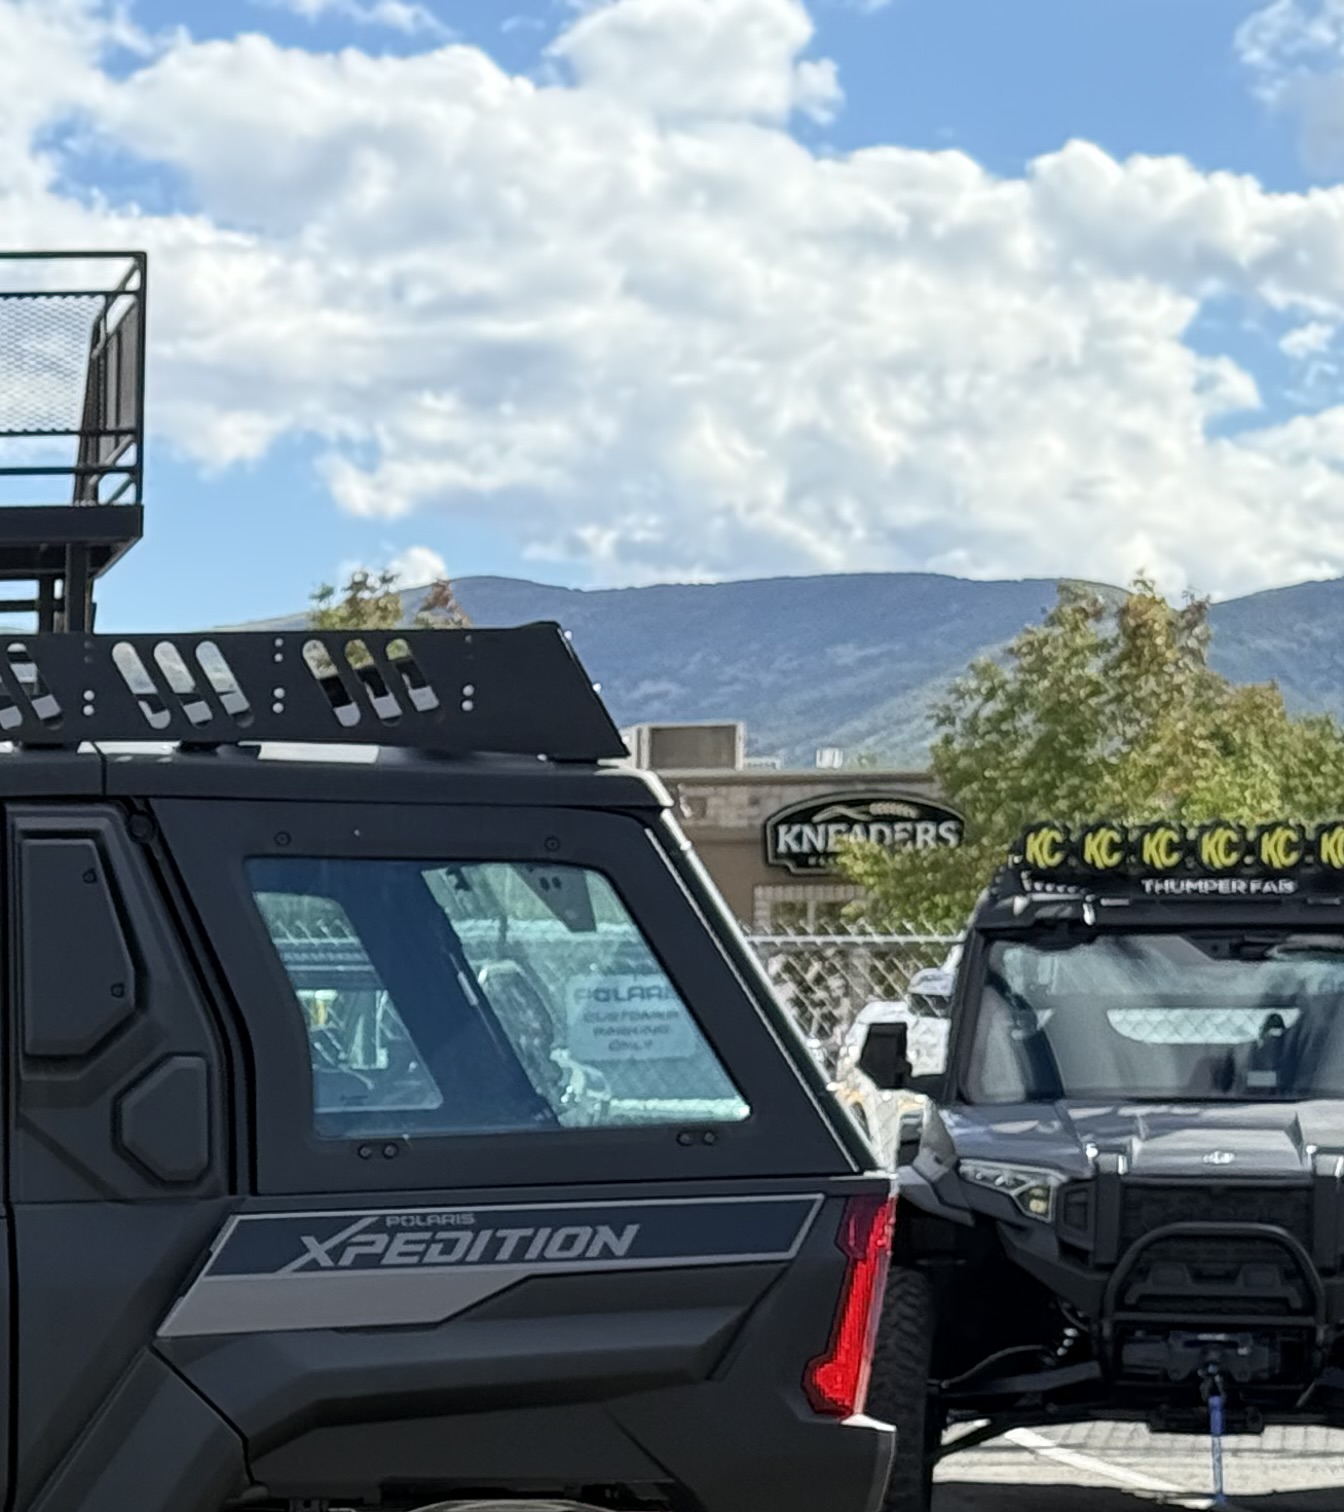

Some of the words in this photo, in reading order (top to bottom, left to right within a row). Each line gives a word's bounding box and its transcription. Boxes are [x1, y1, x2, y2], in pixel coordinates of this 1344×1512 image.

[777, 820, 960, 854] KNEADERS
[1026, 828, 1063, 869] KC
[1084, 827, 1122, 870] KC
[1143, 827, 1180, 869] KC
[1201, 827, 1240, 870] KC
[1261, 827, 1300, 869] KC
[1321, 826, 1344, 869] K
[1141, 878, 1247, 894] THUMPER
[1250, 877, 1298, 895] FAB
[385, 1212, 475, 1228] POLARIS
[274, 1215, 641, 1276] XPEDITION
